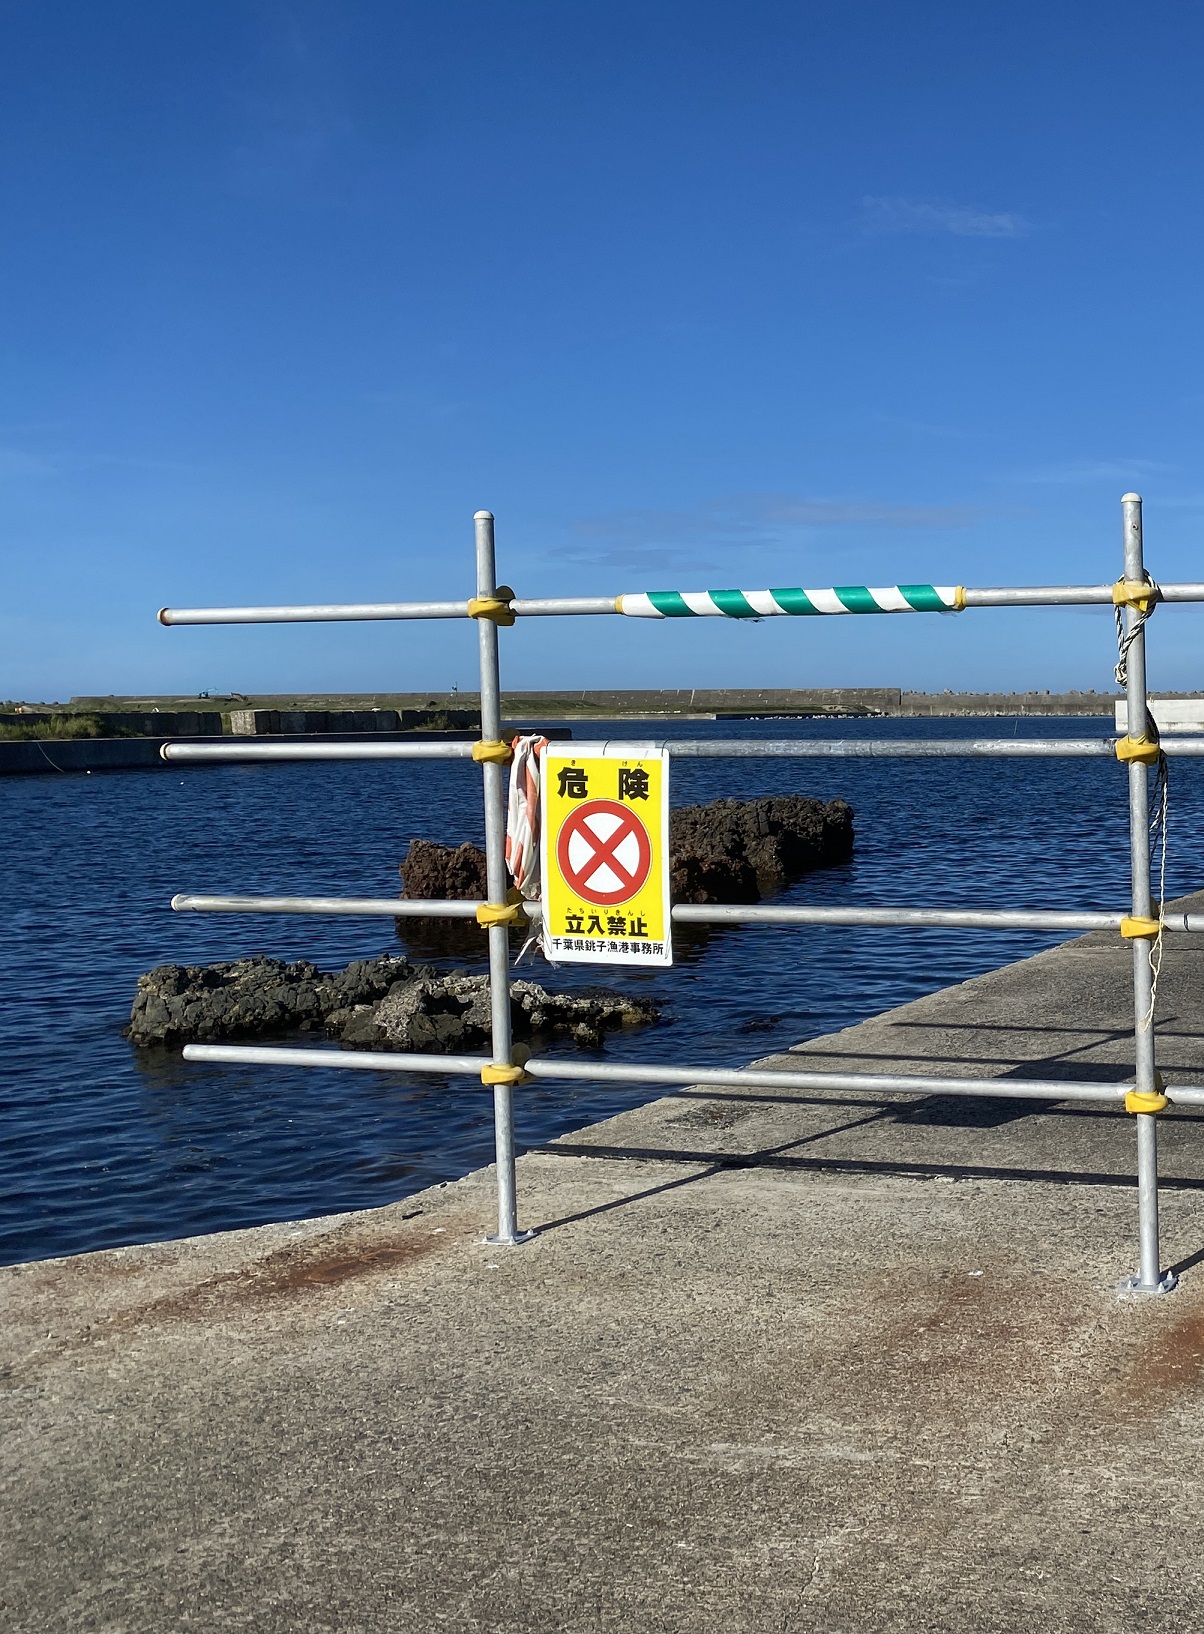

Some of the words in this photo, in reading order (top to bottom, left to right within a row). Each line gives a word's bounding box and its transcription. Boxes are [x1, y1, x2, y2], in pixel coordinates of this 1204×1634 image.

[557, 766, 651, 801] 危険
[566, 907, 646, 917] たちいりきんし
[565, 914, 649, 937] 立入禁止
[552, 938, 664, 955] 千葉県銚子漁港事務所
